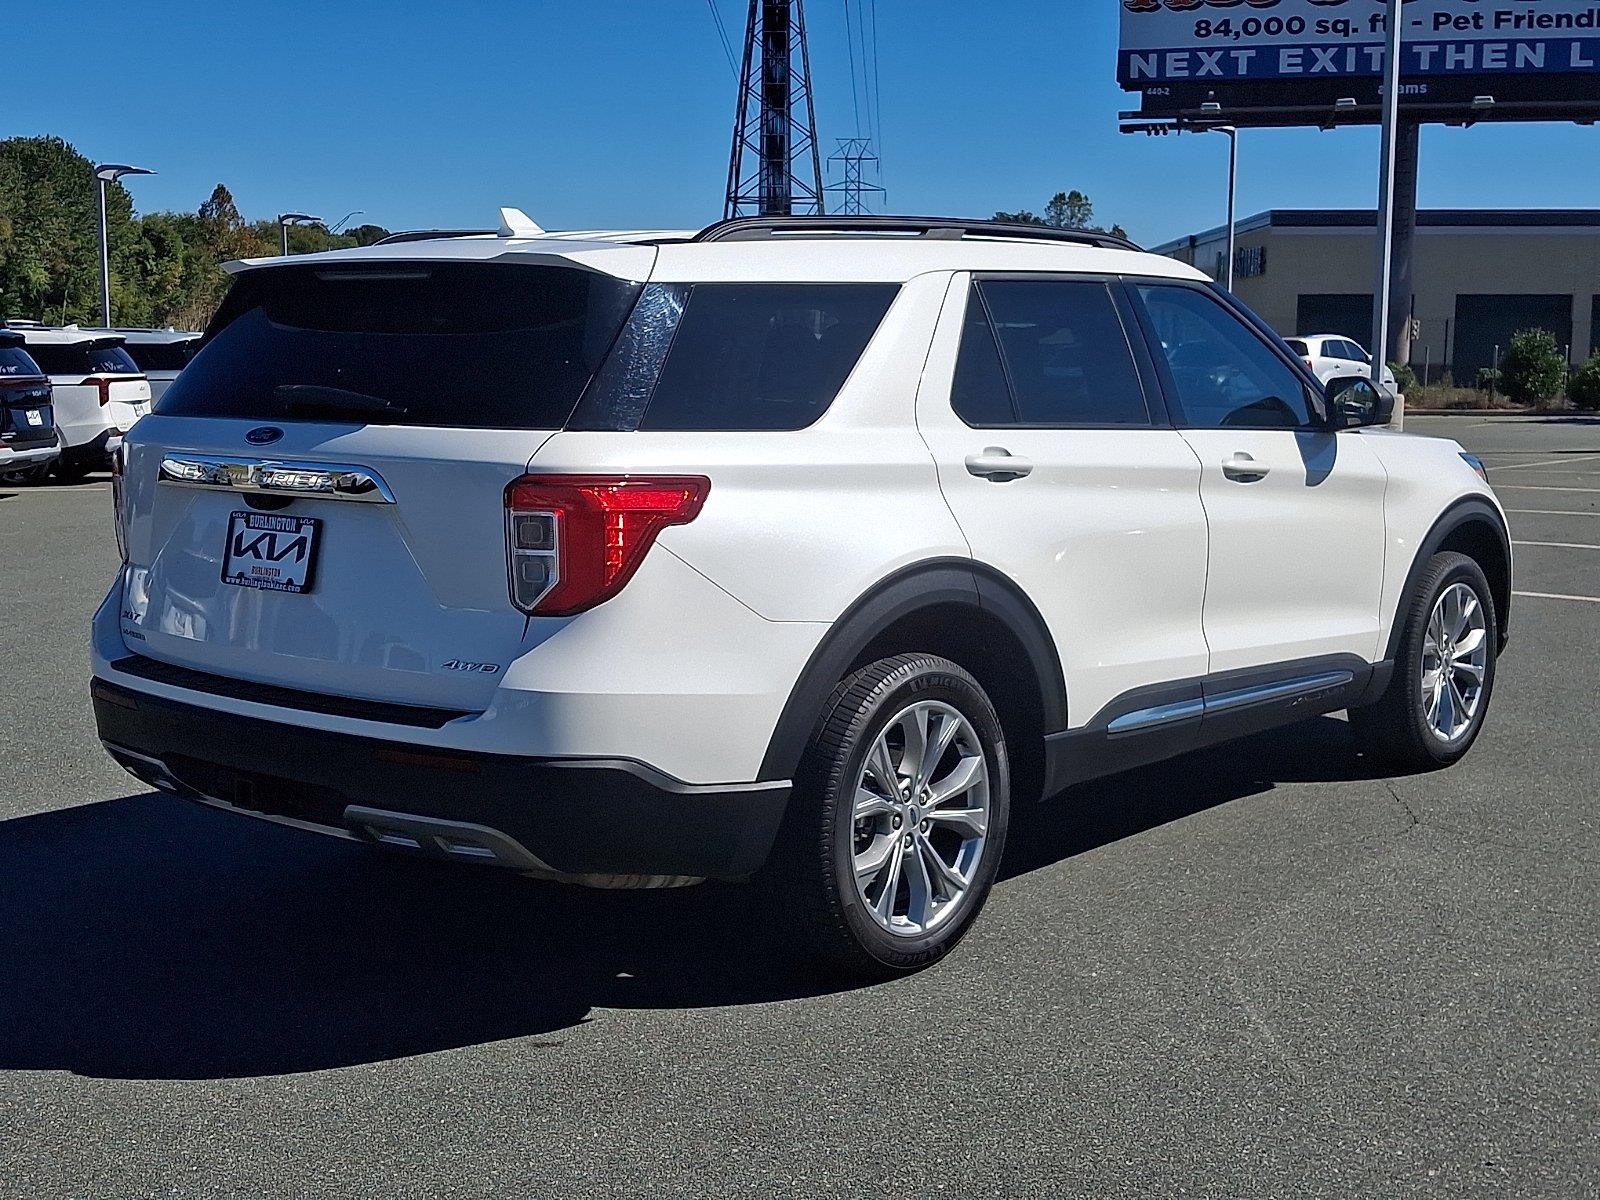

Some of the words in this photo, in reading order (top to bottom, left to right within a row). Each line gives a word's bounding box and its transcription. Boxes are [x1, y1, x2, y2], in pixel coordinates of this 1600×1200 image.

[1194, 16, 1306, 40] 84,000
[1315, 18, 1359, 37] sq.
[1433, 11, 1484, 31] Pet
[1129, 50, 1256, 79] NEXT
[1279, 47, 1387, 73] EXIT
[1412, 43, 1546, 70] THEN
[1570, 42, 1594, 67] L
[1378, 83, 1427, 95] aams
[249, 514, 297, 532] BURLINGTON
[233, 529, 308, 564] KIA
[440, 659, 500, 674] 4WD
